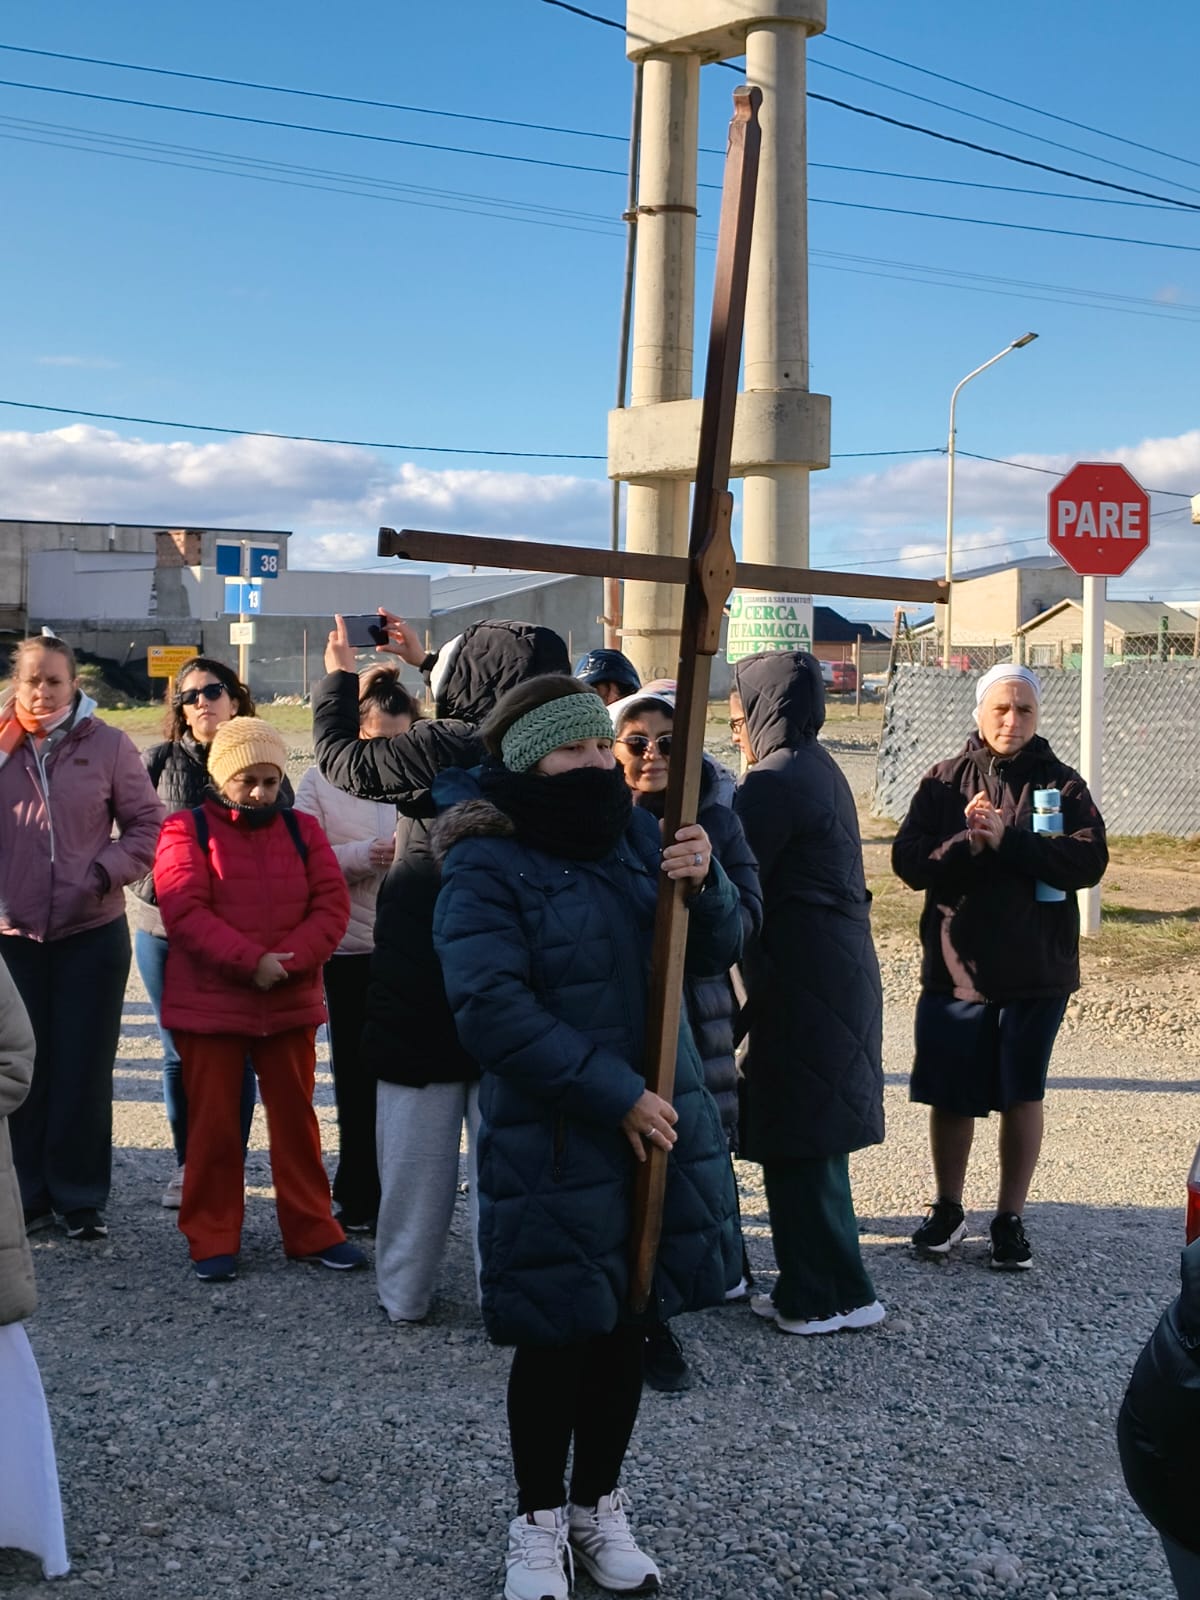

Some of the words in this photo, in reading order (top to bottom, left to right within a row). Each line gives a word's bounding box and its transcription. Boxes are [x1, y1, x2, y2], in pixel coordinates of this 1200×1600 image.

[1057, 500, 1141, 539] PARE
[261, 555, 278, 572] 38
[248, 591, 259, 608] 13
[745, 605, 798, 621] CERCA
[730, 623, 740, 638] TU
[741, 623, 810, 639] FARMACIA
[792, 643, 809, 652] 15
